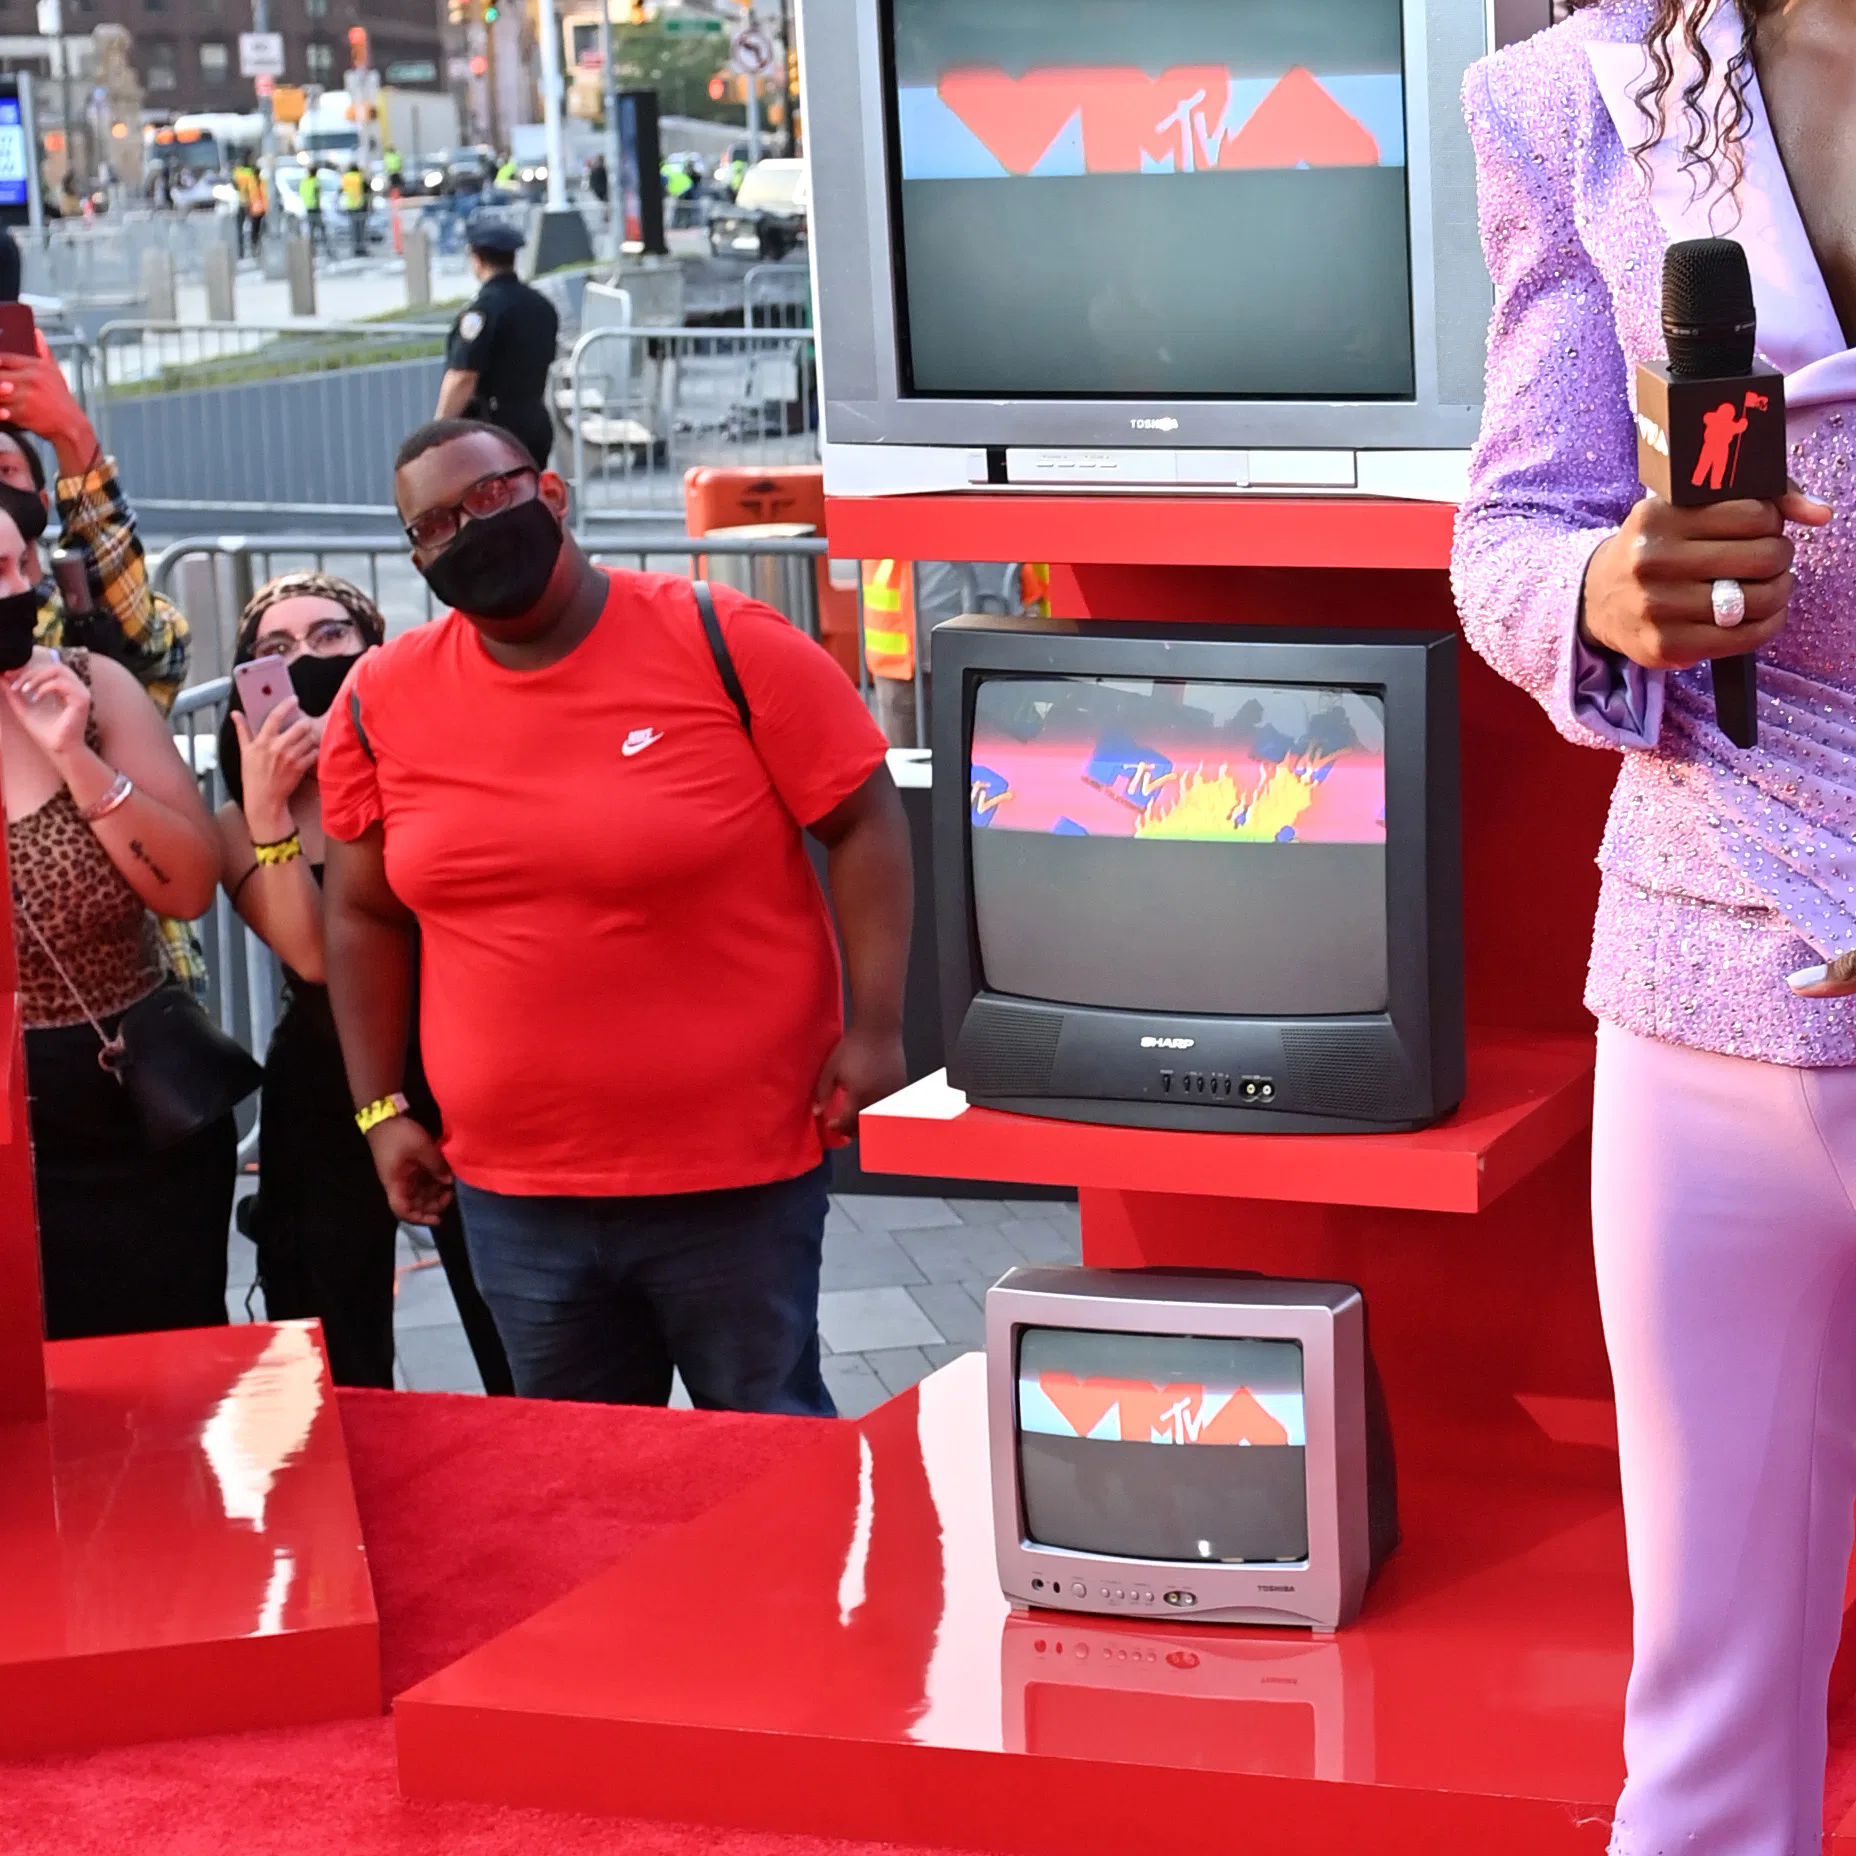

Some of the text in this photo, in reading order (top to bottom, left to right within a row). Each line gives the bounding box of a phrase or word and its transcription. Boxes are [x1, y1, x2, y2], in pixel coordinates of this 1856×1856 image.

[1130, 417, 1179, 430] TOSHA
[1140, 1036, 1195, 1050] SHARP
[1257, 1584, 1297, 1594] TOSHIBA
